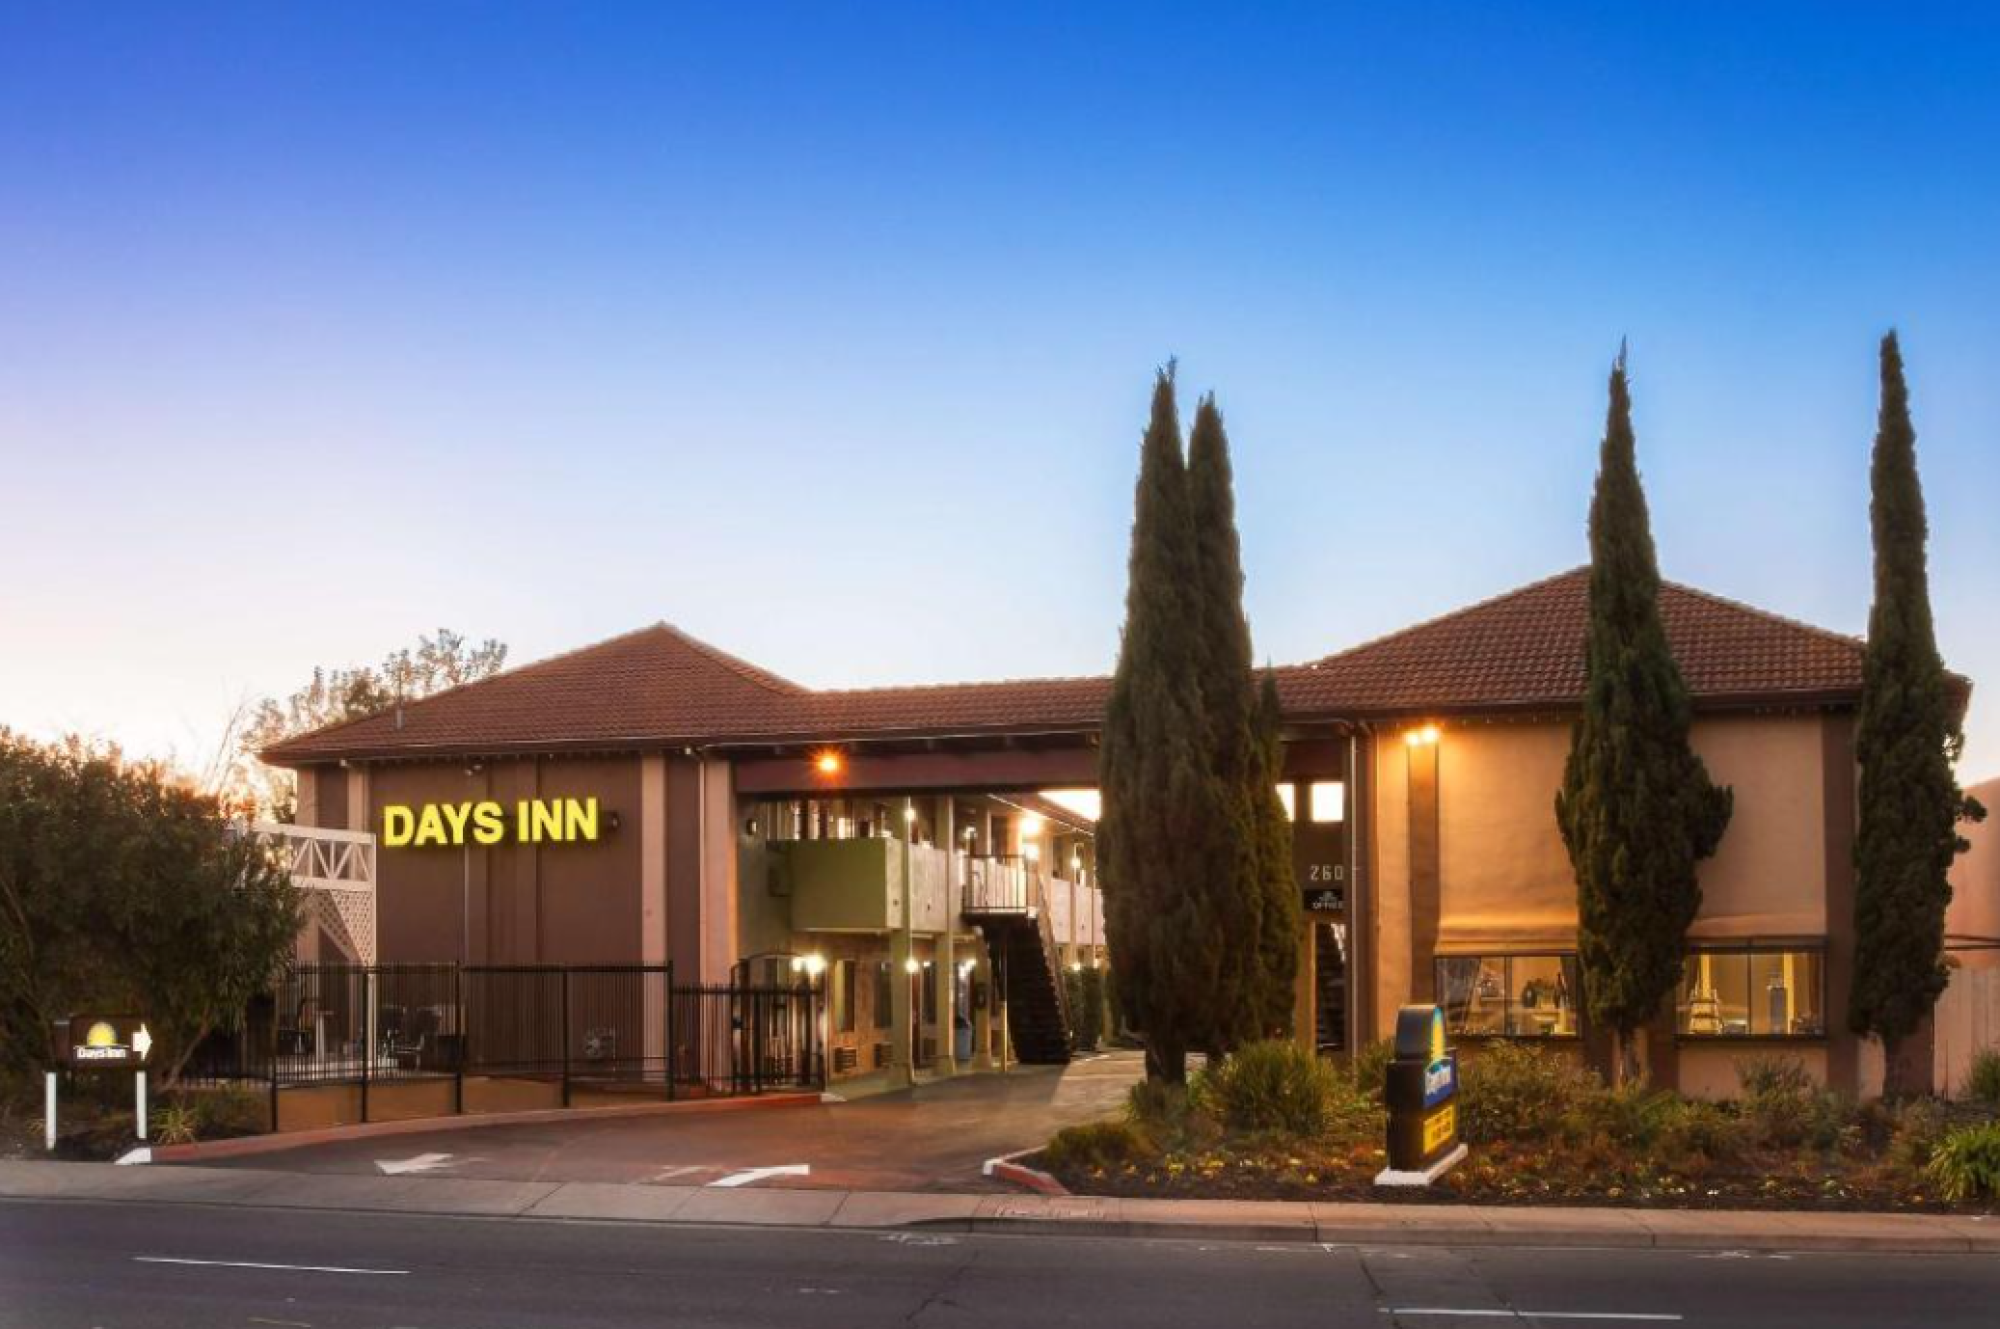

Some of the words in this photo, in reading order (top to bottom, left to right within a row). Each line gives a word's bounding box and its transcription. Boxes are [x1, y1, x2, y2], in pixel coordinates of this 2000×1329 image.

[384, 801, 504, 847] DAYS
[518, 797, 598, 843] INN
[1310, 864, 1344, 880] 260
